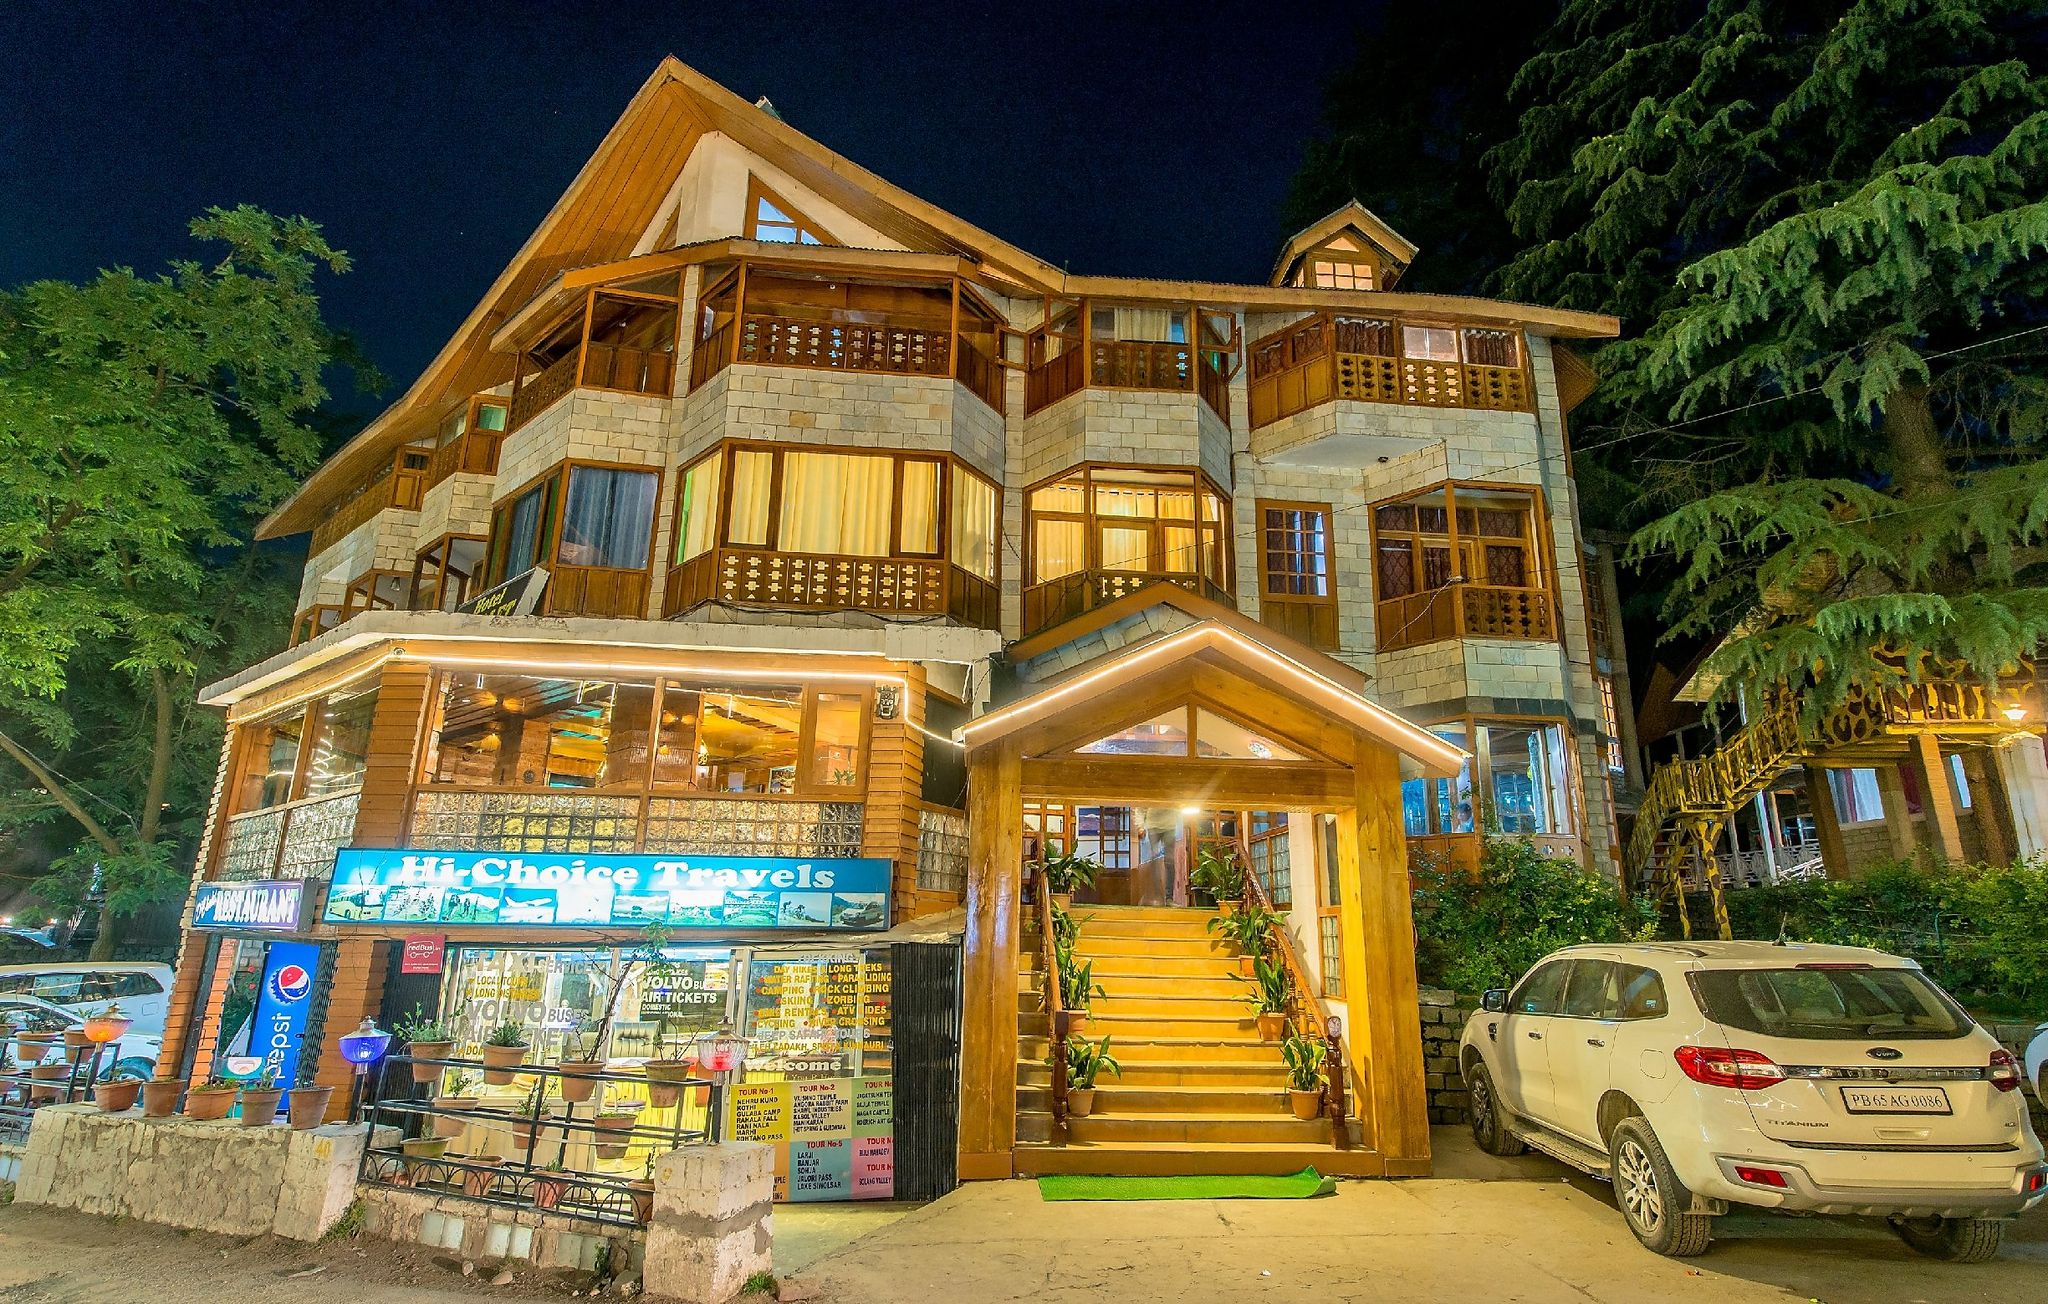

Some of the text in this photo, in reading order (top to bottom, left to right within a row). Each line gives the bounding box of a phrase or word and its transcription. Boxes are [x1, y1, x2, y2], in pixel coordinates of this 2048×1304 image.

[401, 856, 836, 888] Hi-Choice Travels
[213, 888, 299, 923] RESTAURANT
[774, 965, 790, 974] DAY
[792, 965, 817, 974] HIKES
[828, 964, 852, 973] LONG
[853, 963, 882, 972] TREKS
[476, 976, 501, 986] LOCAL
[838, 972, 892, 983] PARAGLIDING
[642, 976, 704, 990] VOLVO BU
[475, 988, 496, 998] LONG
[761, 986, 804, 995] CAMPING
[842, 984, 889, 993] CLIMBING
[640, 991, 717, 1004] AIR TICKETS
[782, 996, 813, 1005] SKIING
[827, 995, 870, 1004] ZORBING
[466, 999, 547, 1022] VOLVO
[837, 1006, 855, 1015] ATV
[838, 1017, 885, 1026] CROSSING
[264, 1012, 291, 1079] pepsi
[1851, 1094, 1943, 1108] PB 65 AG 0086
[1765, 1119, 1829, 1128] TITANIUM
[807, 1141, 825, 1149] TOUR
[818, 1173, 833, 1181] PASS
[797, 1182, 812, 1190] LAKE
